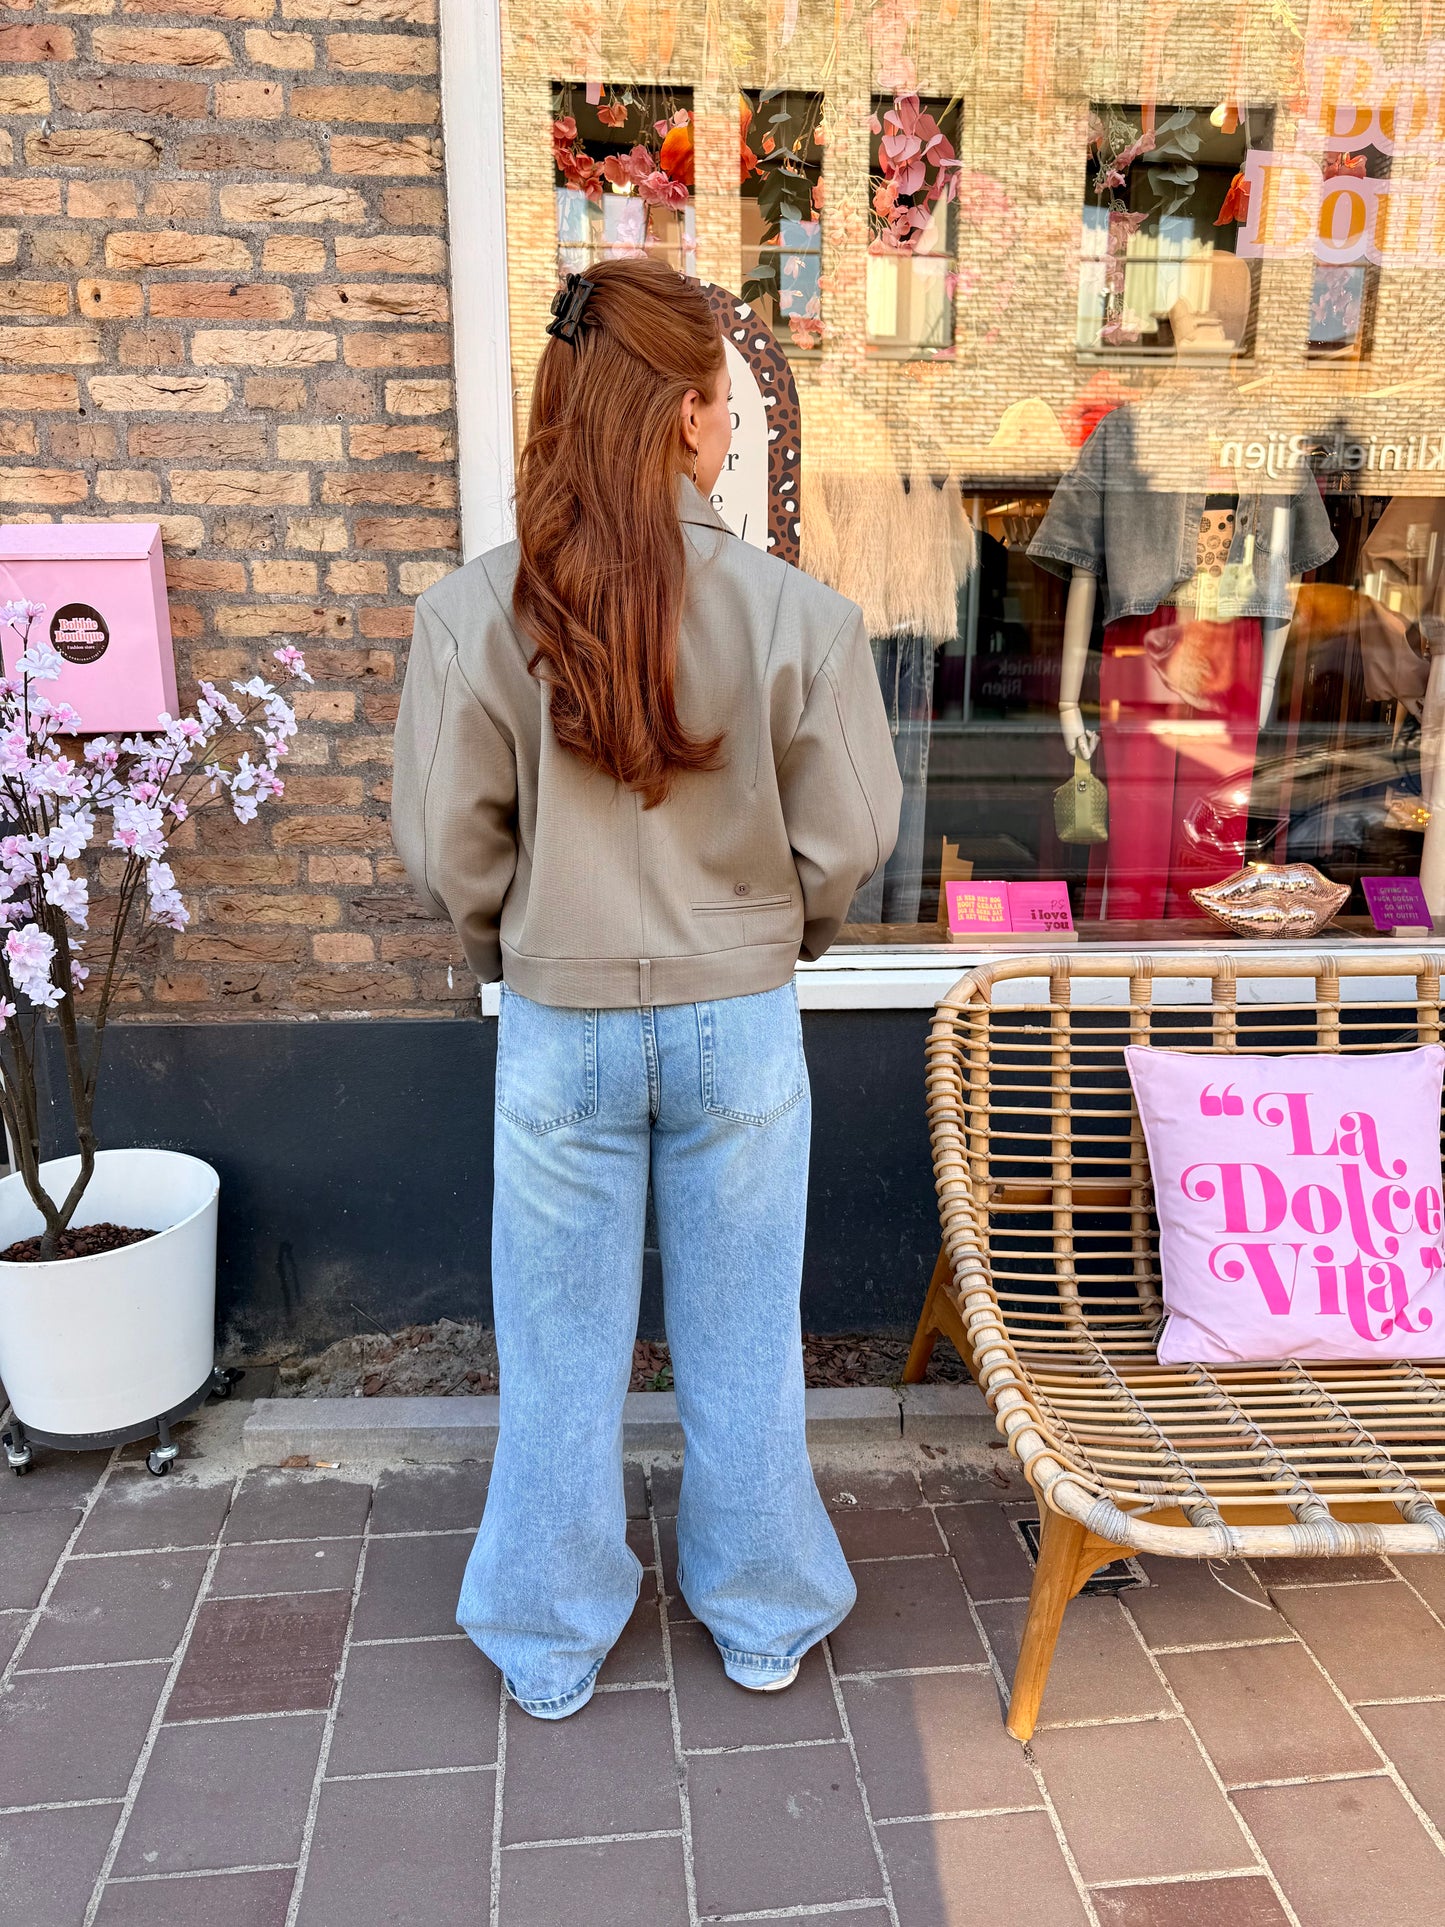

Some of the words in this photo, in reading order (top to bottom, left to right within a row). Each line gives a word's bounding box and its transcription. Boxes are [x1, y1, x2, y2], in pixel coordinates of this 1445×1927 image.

[59, 618, 98, 630] Bobbie
[54, 631, 105, 644] Boutique
[1030, 909, 1037, 920] i
[1038, 909, 1068, 920] love
[1044, 921, 1070, 932] you
[1180, 1162, 1441, 1260] Dolce
